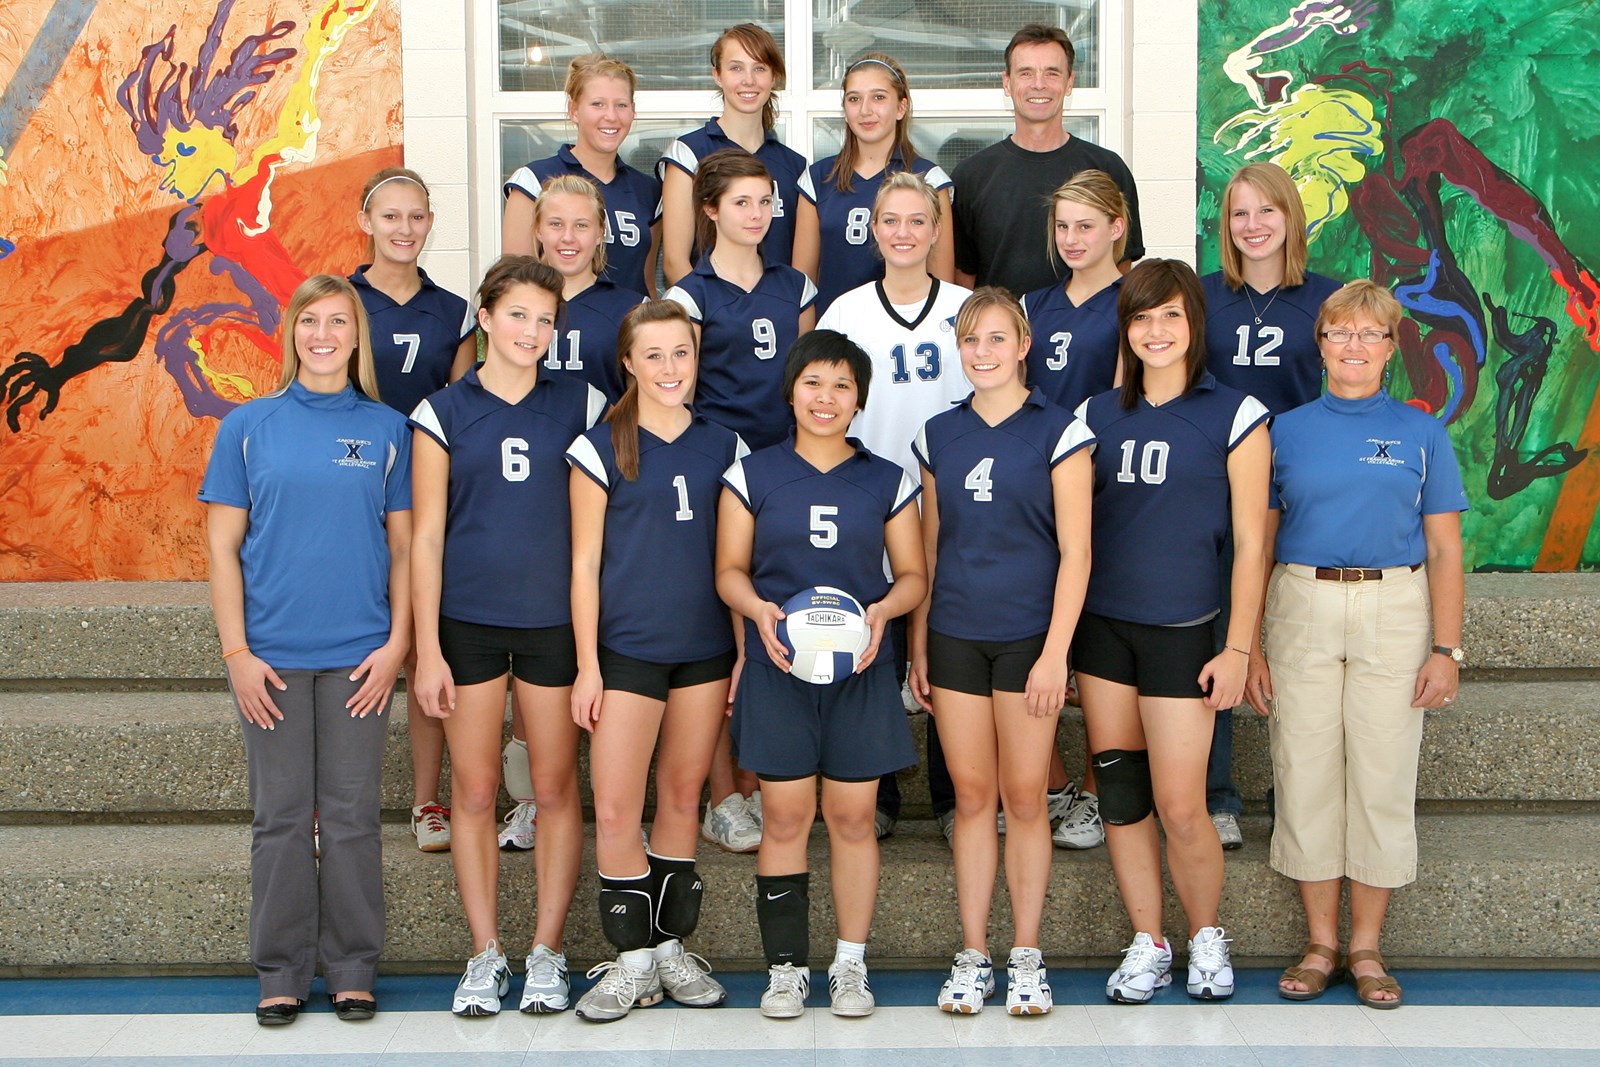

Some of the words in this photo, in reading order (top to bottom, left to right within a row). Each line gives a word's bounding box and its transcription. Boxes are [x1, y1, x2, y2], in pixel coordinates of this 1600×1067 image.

[845, 207, 871, 245] 8
[393, 334, 420, 373] 7
[544, 329, 583, 370] 11
[752, 318, 777, 360] 9
[1046, 332, 1072, 370] 3
[1233, 325, 1284, 366] 12
[890, 341, 942, 384] 13
[501, 437, 530, 482] 6
[965, 457, 995, 502] 4
[1117, 439, 1170, 485] 10
[672, 475, 693, 521] 1
[810, 505, 838, 549] 5
[806, 613, 845, 623] TACHIKARA
